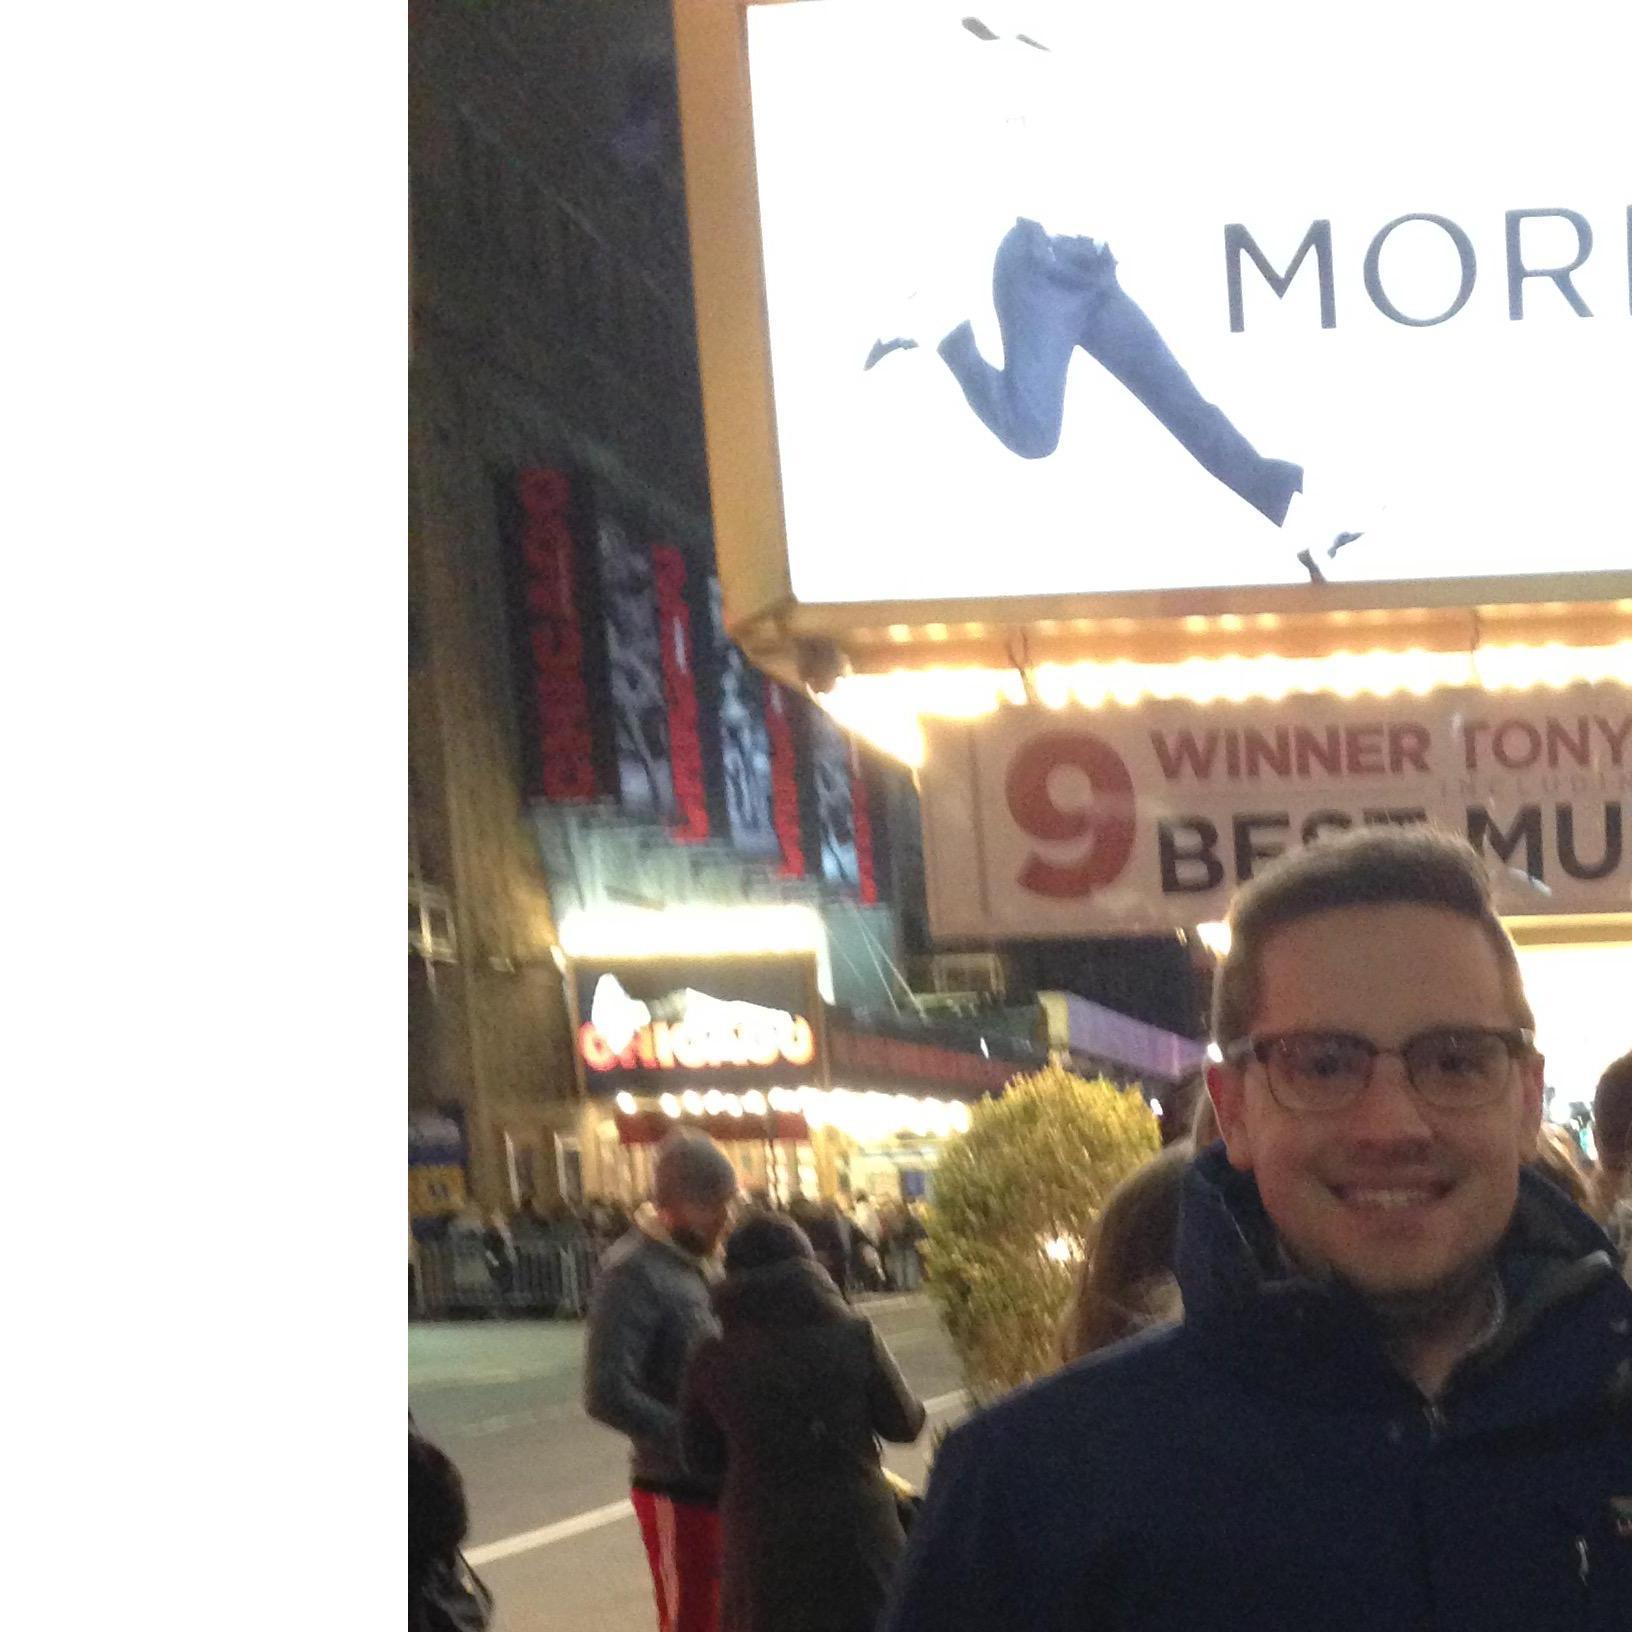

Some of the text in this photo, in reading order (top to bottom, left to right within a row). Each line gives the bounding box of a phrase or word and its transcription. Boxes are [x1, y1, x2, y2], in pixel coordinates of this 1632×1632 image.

[1149, 720, 1432, 780] WINNER
[1005, 728, 1138, 899] 9
[1157, 806, 1428, 894] BE
